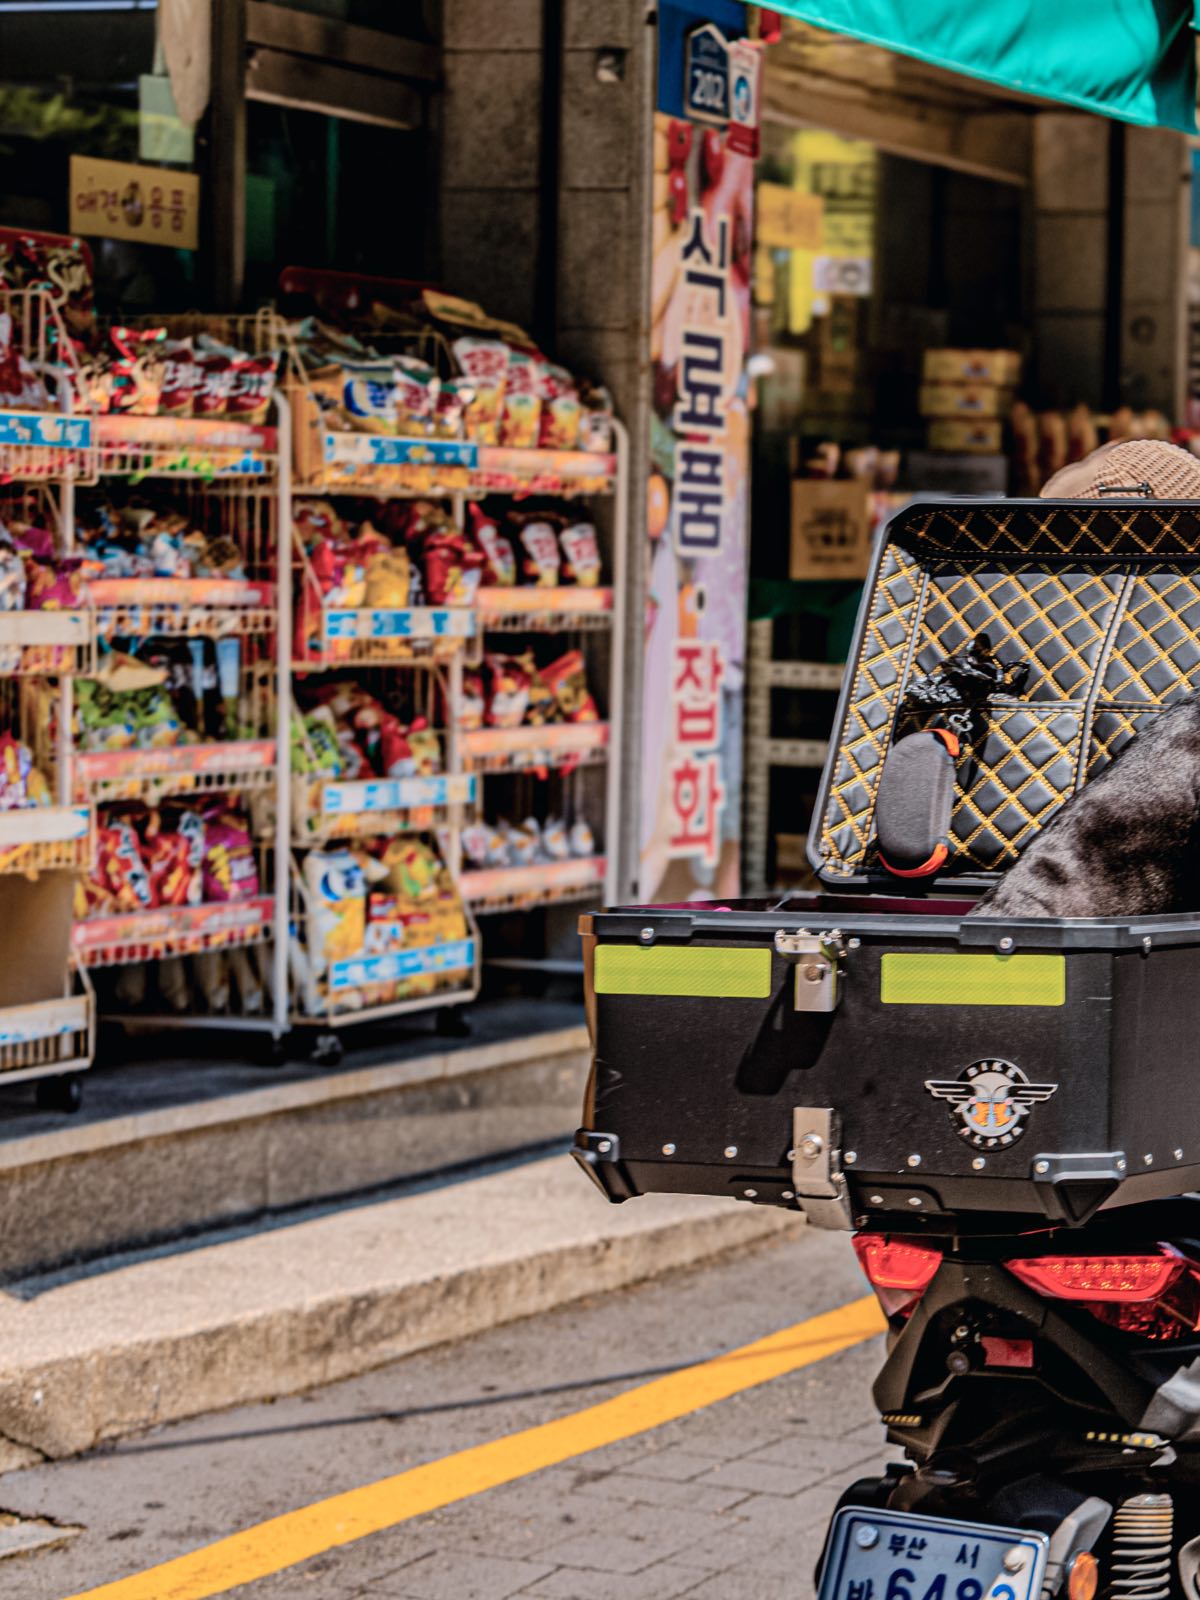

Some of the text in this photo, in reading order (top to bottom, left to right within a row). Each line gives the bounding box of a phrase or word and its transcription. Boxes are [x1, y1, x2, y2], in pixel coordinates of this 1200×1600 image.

[692, 69, 725, 108] 202
[669, 214, 726, 859] 식료품 잡화
[966, 1061, 1017, 1080] BIKE
[957, 1126, 1024, 1148] ALPHA
[888, 1533, 980, 1569] 부산 서
